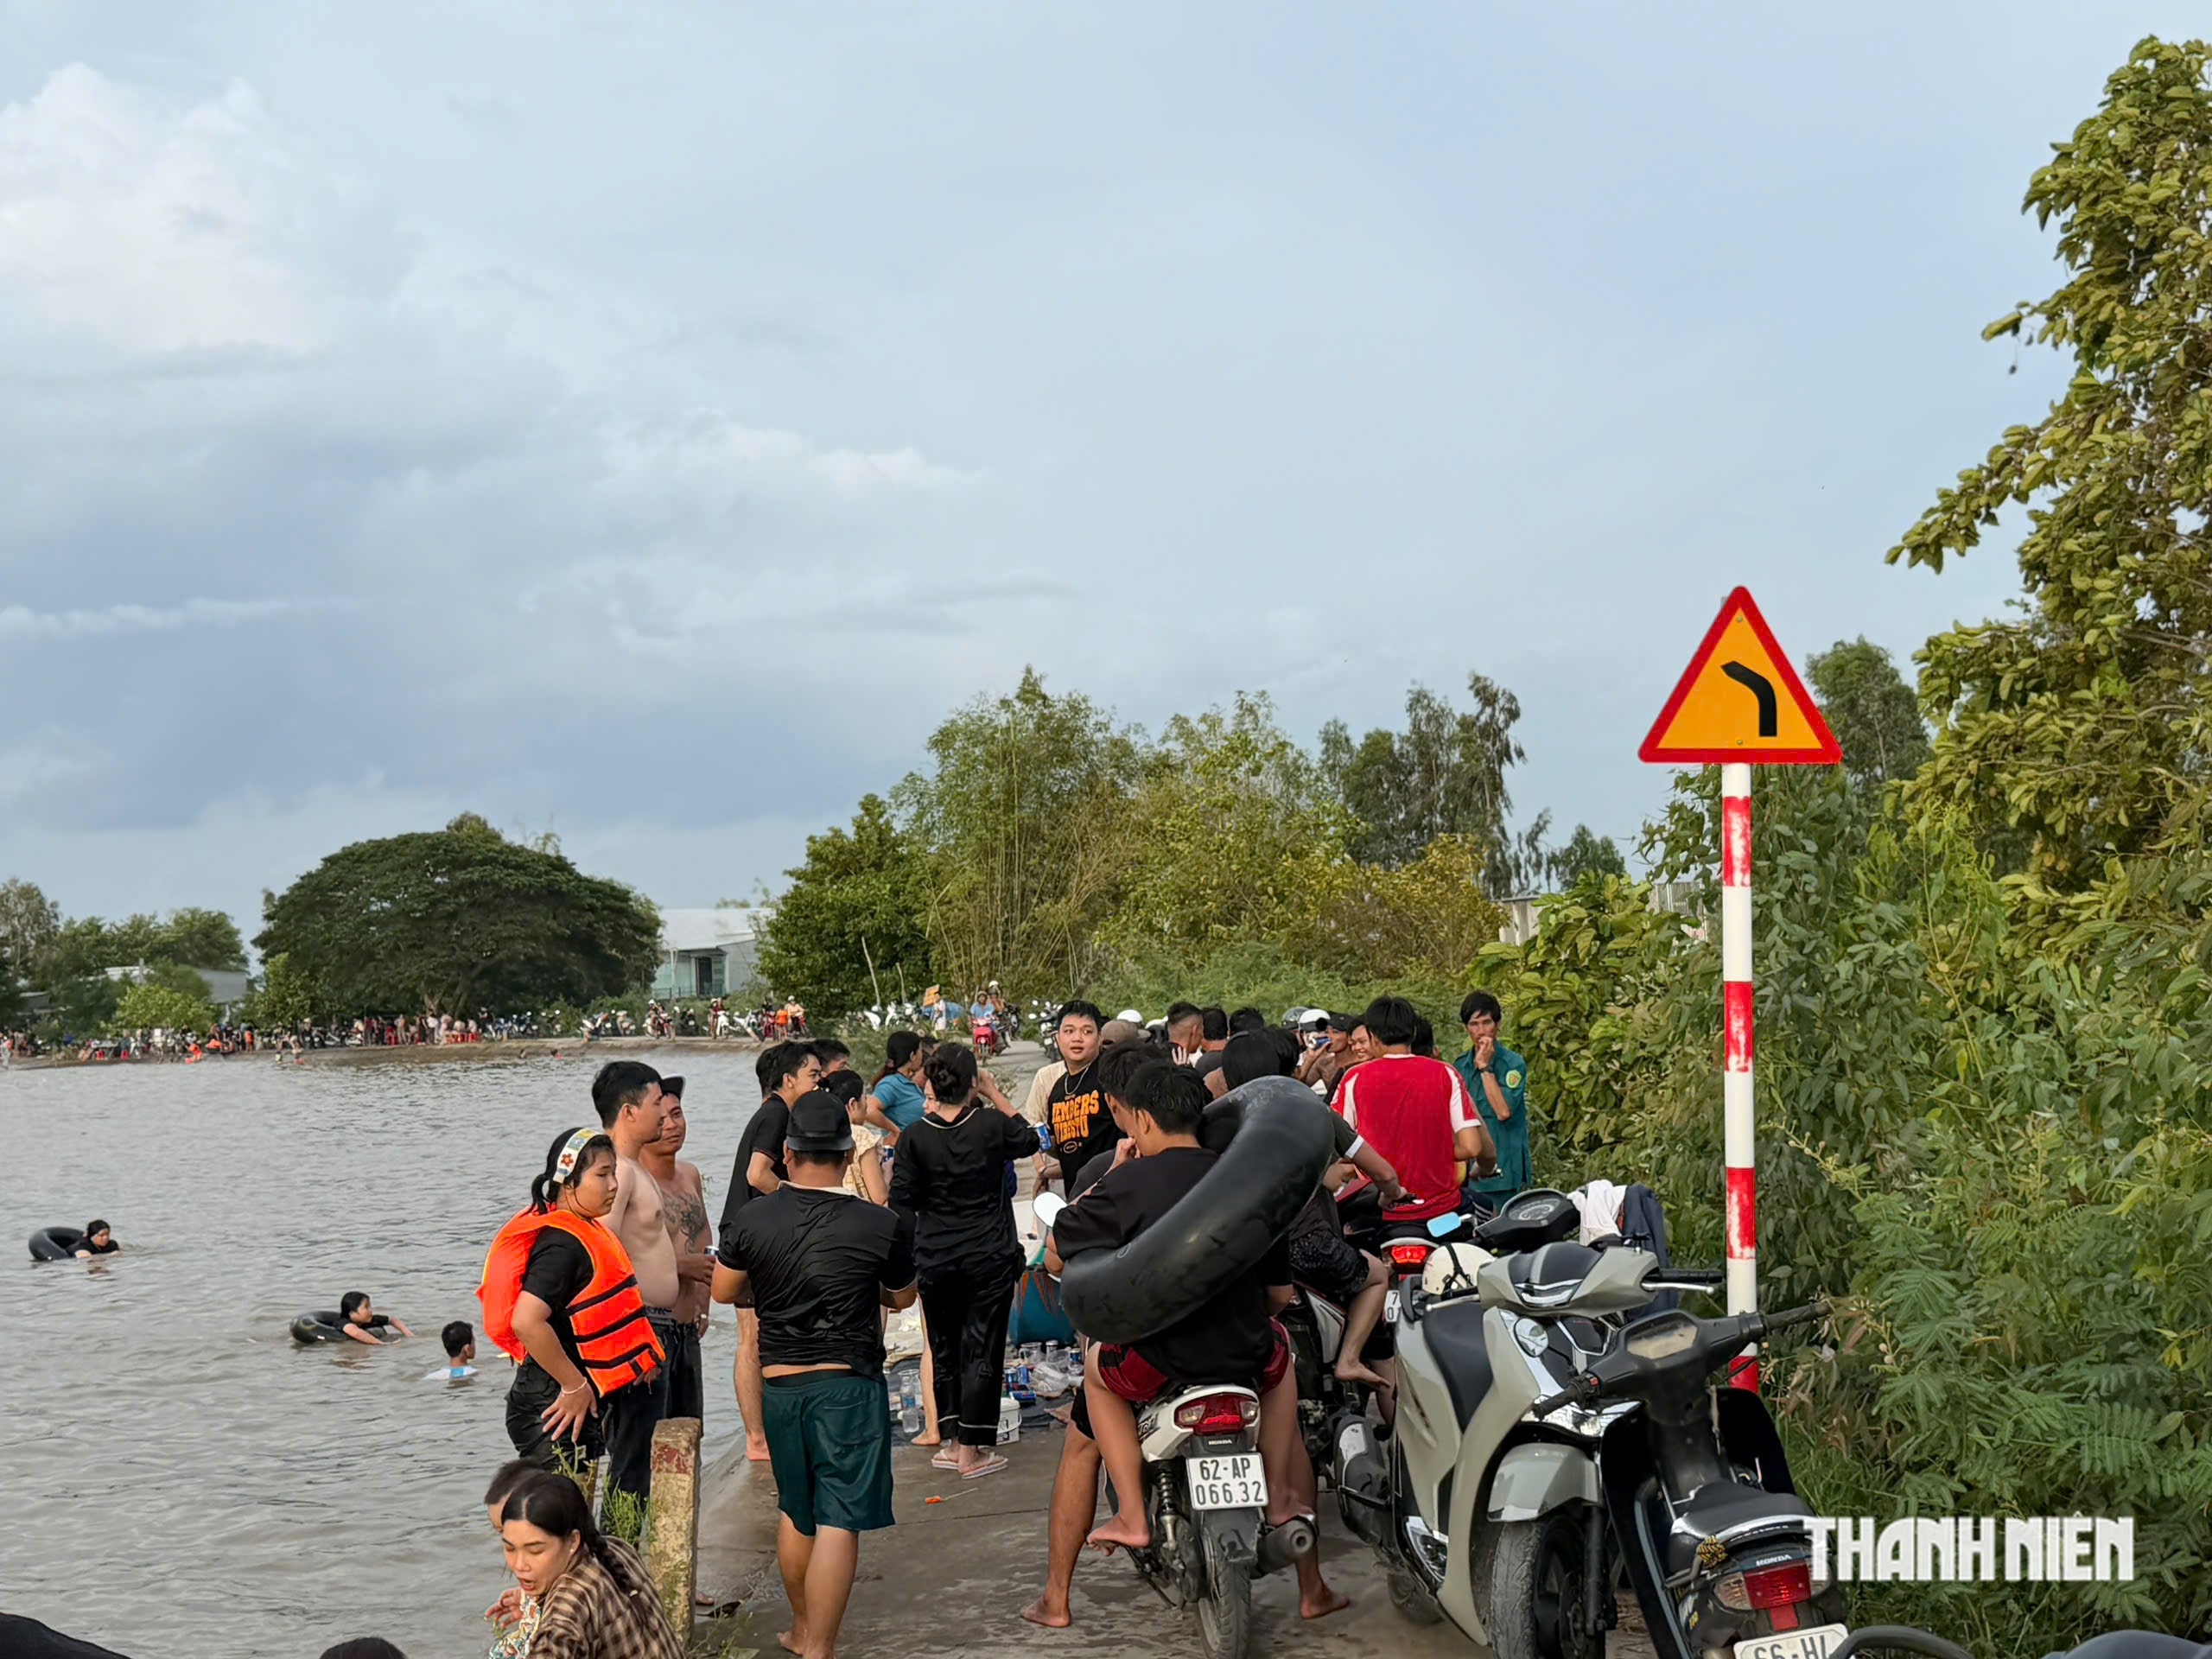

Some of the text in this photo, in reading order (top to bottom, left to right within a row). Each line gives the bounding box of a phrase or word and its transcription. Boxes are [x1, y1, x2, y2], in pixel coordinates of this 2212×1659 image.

[1199, 1458, 1250, 1481] 62-AP
[1195, 1481, 1263, 1505] 066.32
[1756, 1554, 1793, 1567] HONDA
